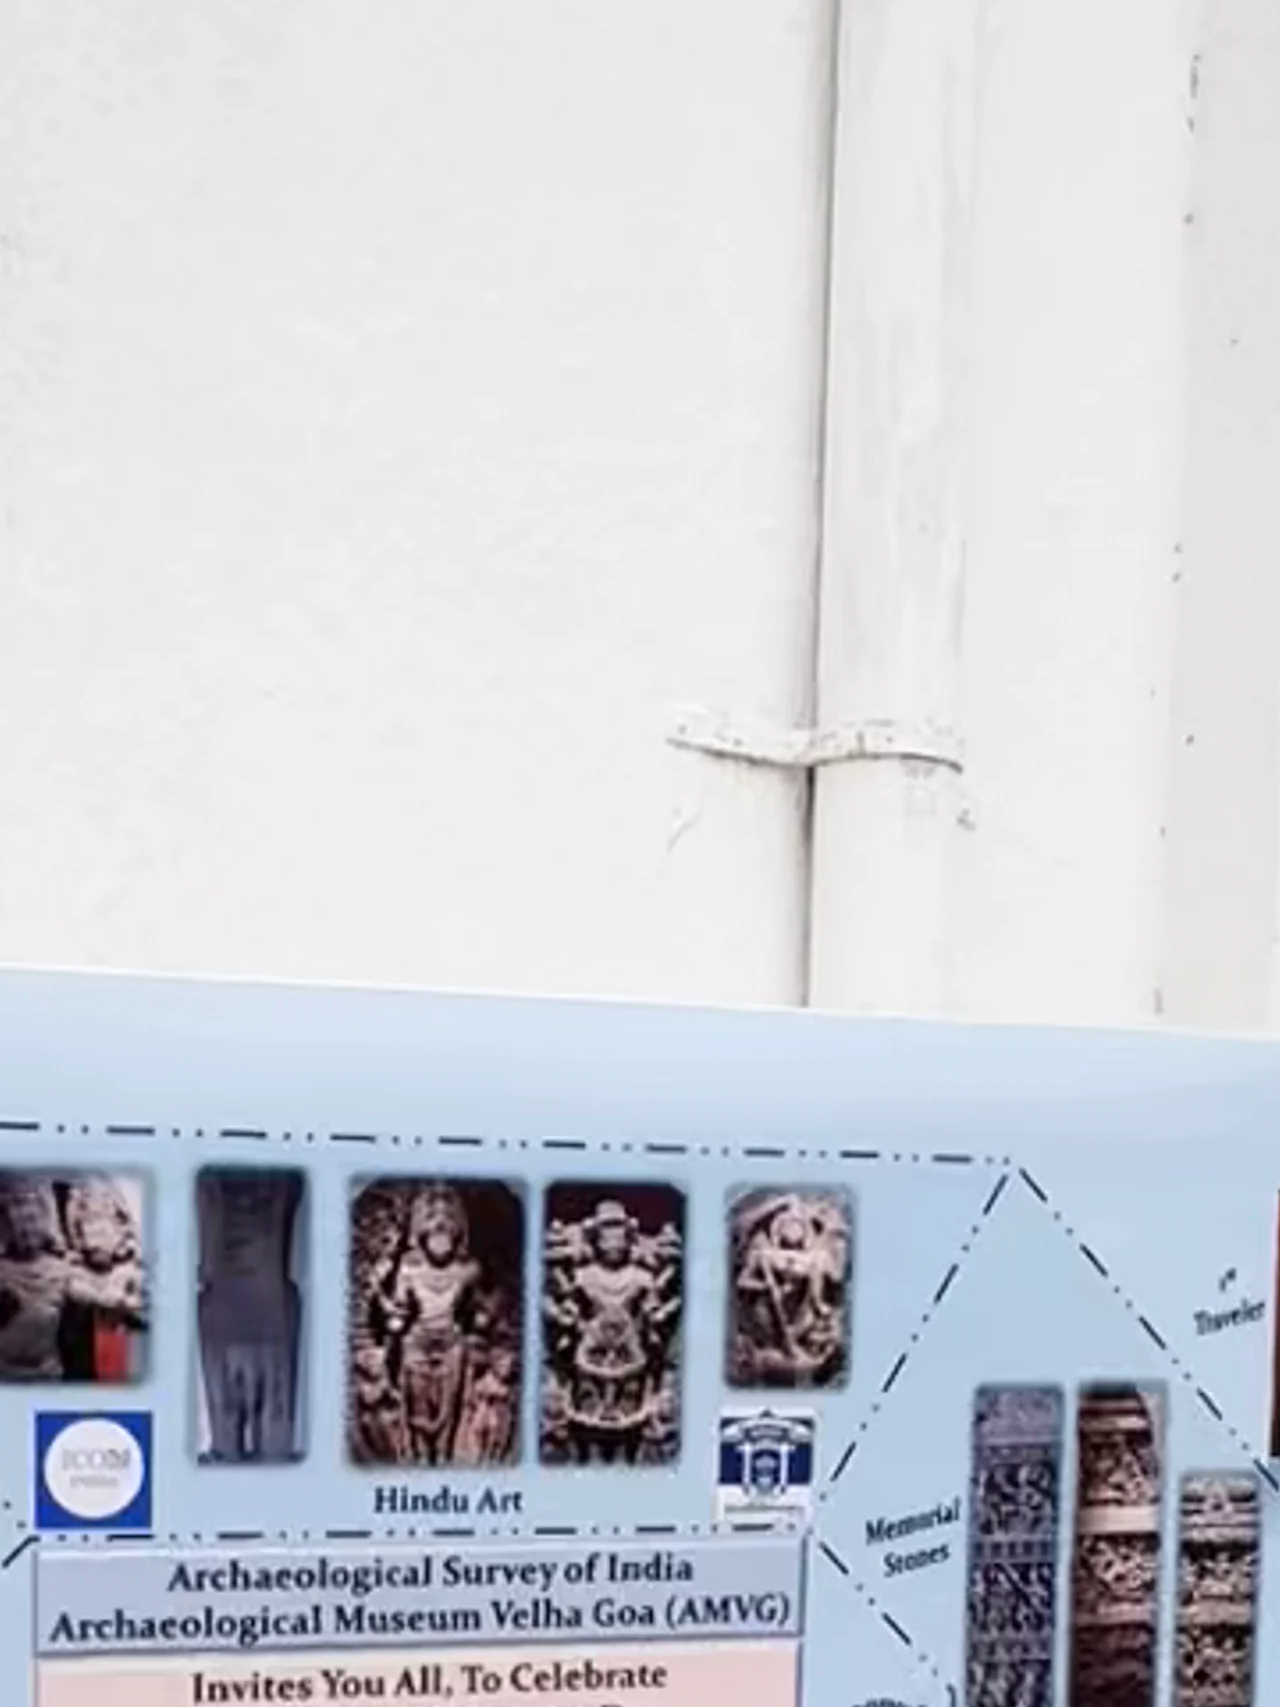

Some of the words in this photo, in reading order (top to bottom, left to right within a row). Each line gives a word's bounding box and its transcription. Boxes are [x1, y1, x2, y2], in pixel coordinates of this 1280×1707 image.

[374, 1487, 468, 1514] Hindu
[477, 1487, 523, 1513] Art
[865, 1495, 960, 1546] Memorial
[167, 1557, 432, 1596] Archaeological
[442, 1556, 558, 1591] Survey
[564, 1552, 600, 1582] of
[608, 1551, 693, 1582] India
[884, 1544, 949, 1578] Stones
[50, 1606, 320, 1647] Archaeological
[334, 1604, 481, 1635] Museum
[491, 1598, 582, 1630] Velha
[593, 1599, 655, 1627] Goa
[665, 1593, 790, 1629] (AMVG)
[193, 1671, 313, 1704] Invites
[321, 1669, 385, 1699] You
[395, 1664, 453, 1699] All,
[461, 1664, 502, 1693] To
[510, 1659, 668, 1692] Celebrate
